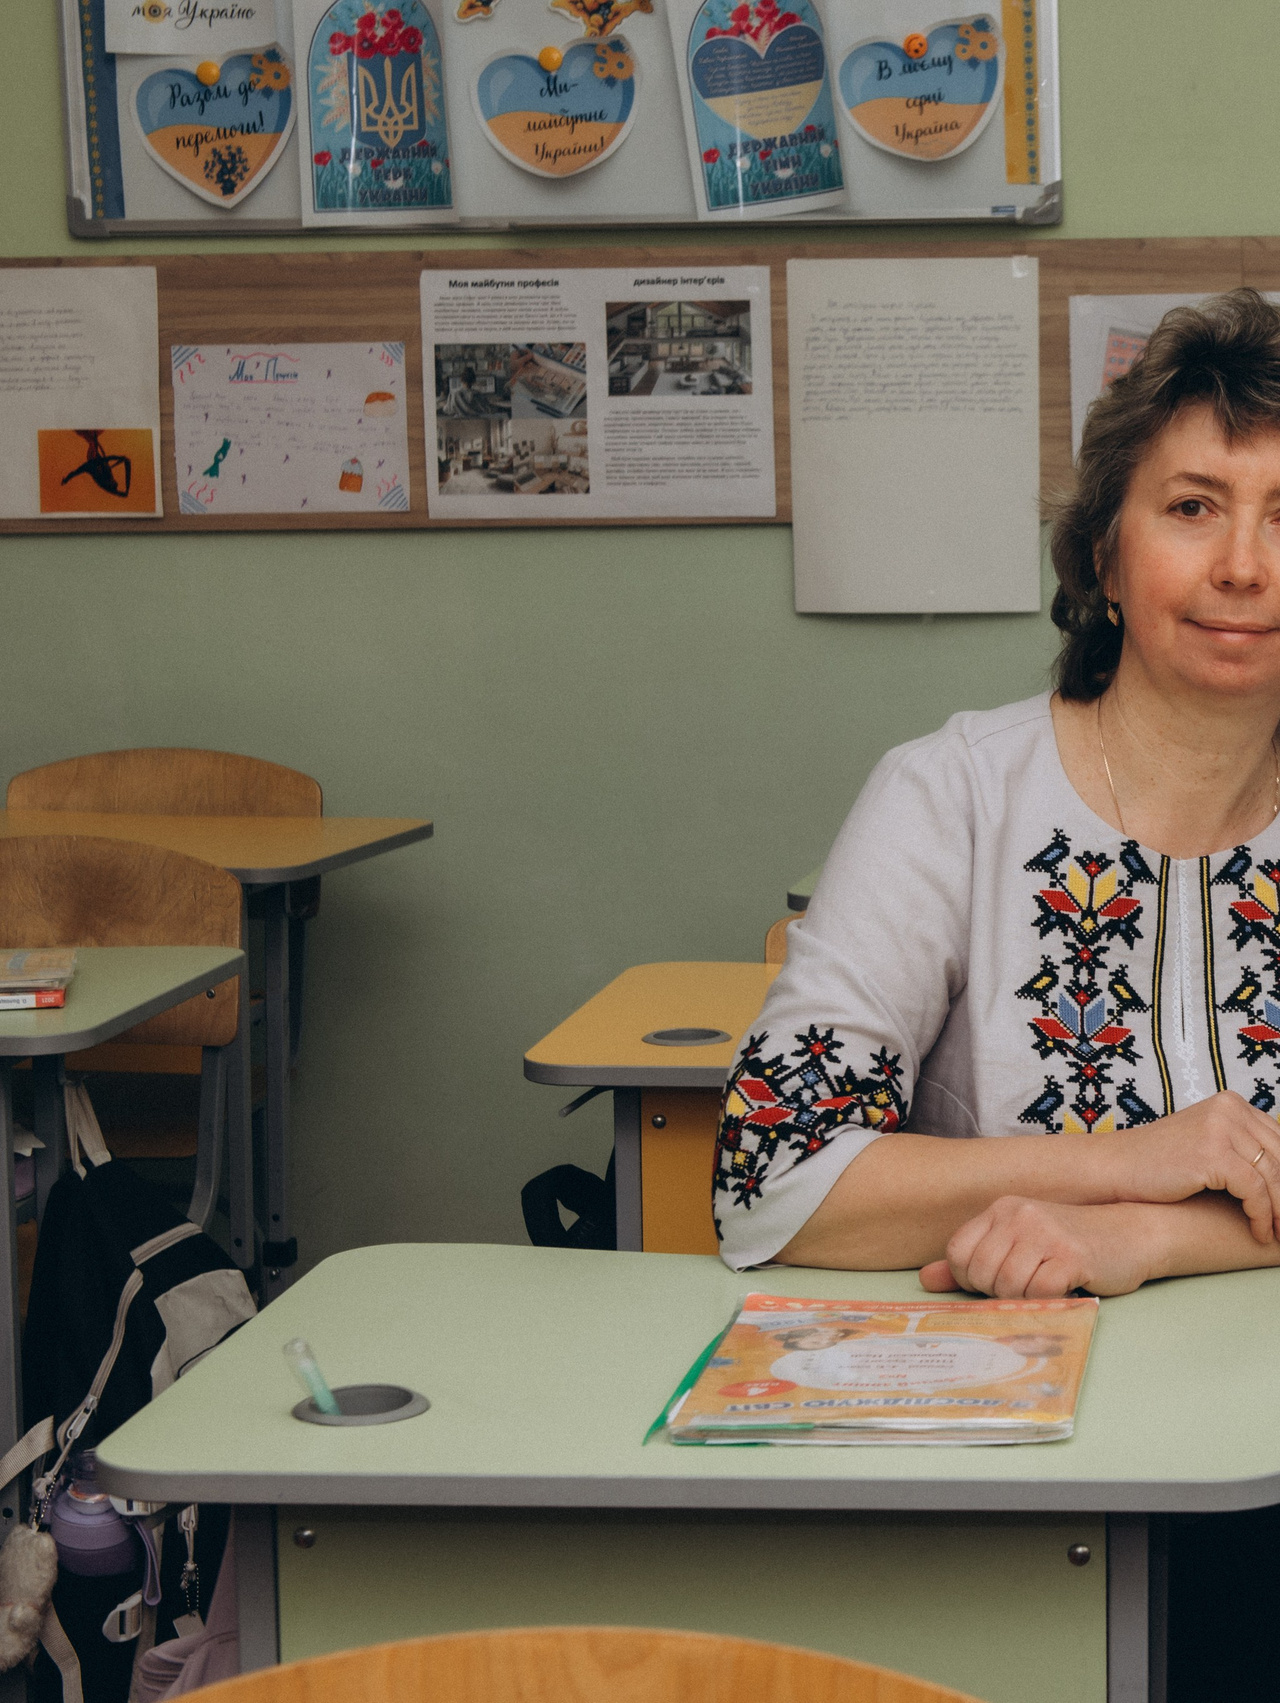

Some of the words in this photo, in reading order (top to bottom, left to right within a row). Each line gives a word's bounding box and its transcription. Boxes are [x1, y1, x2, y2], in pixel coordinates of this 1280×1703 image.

[131, 4, 173, 19] моя
[876, 58, 893, 82] В
[899, 54, 954, 76] моєму
[165, 81, 231, 116] Разом
[238, 78, 259, 107] до
[175, 110, 265, 157] перемоги!
[523, 108, 608, 134] майбутнє
[893, 120, 961, 146] Україна
[533, 135, 605, 165] України!
[448, 279, 469, 289] Моя
[471, 278, 515, 290] майбутня
[517, 277, 559, 290] професія
[633, 276, 678, 287] дизайнер
[746, 1387, 771, 1397] 4
[727, 1401, 793, 1412] СВІТ
